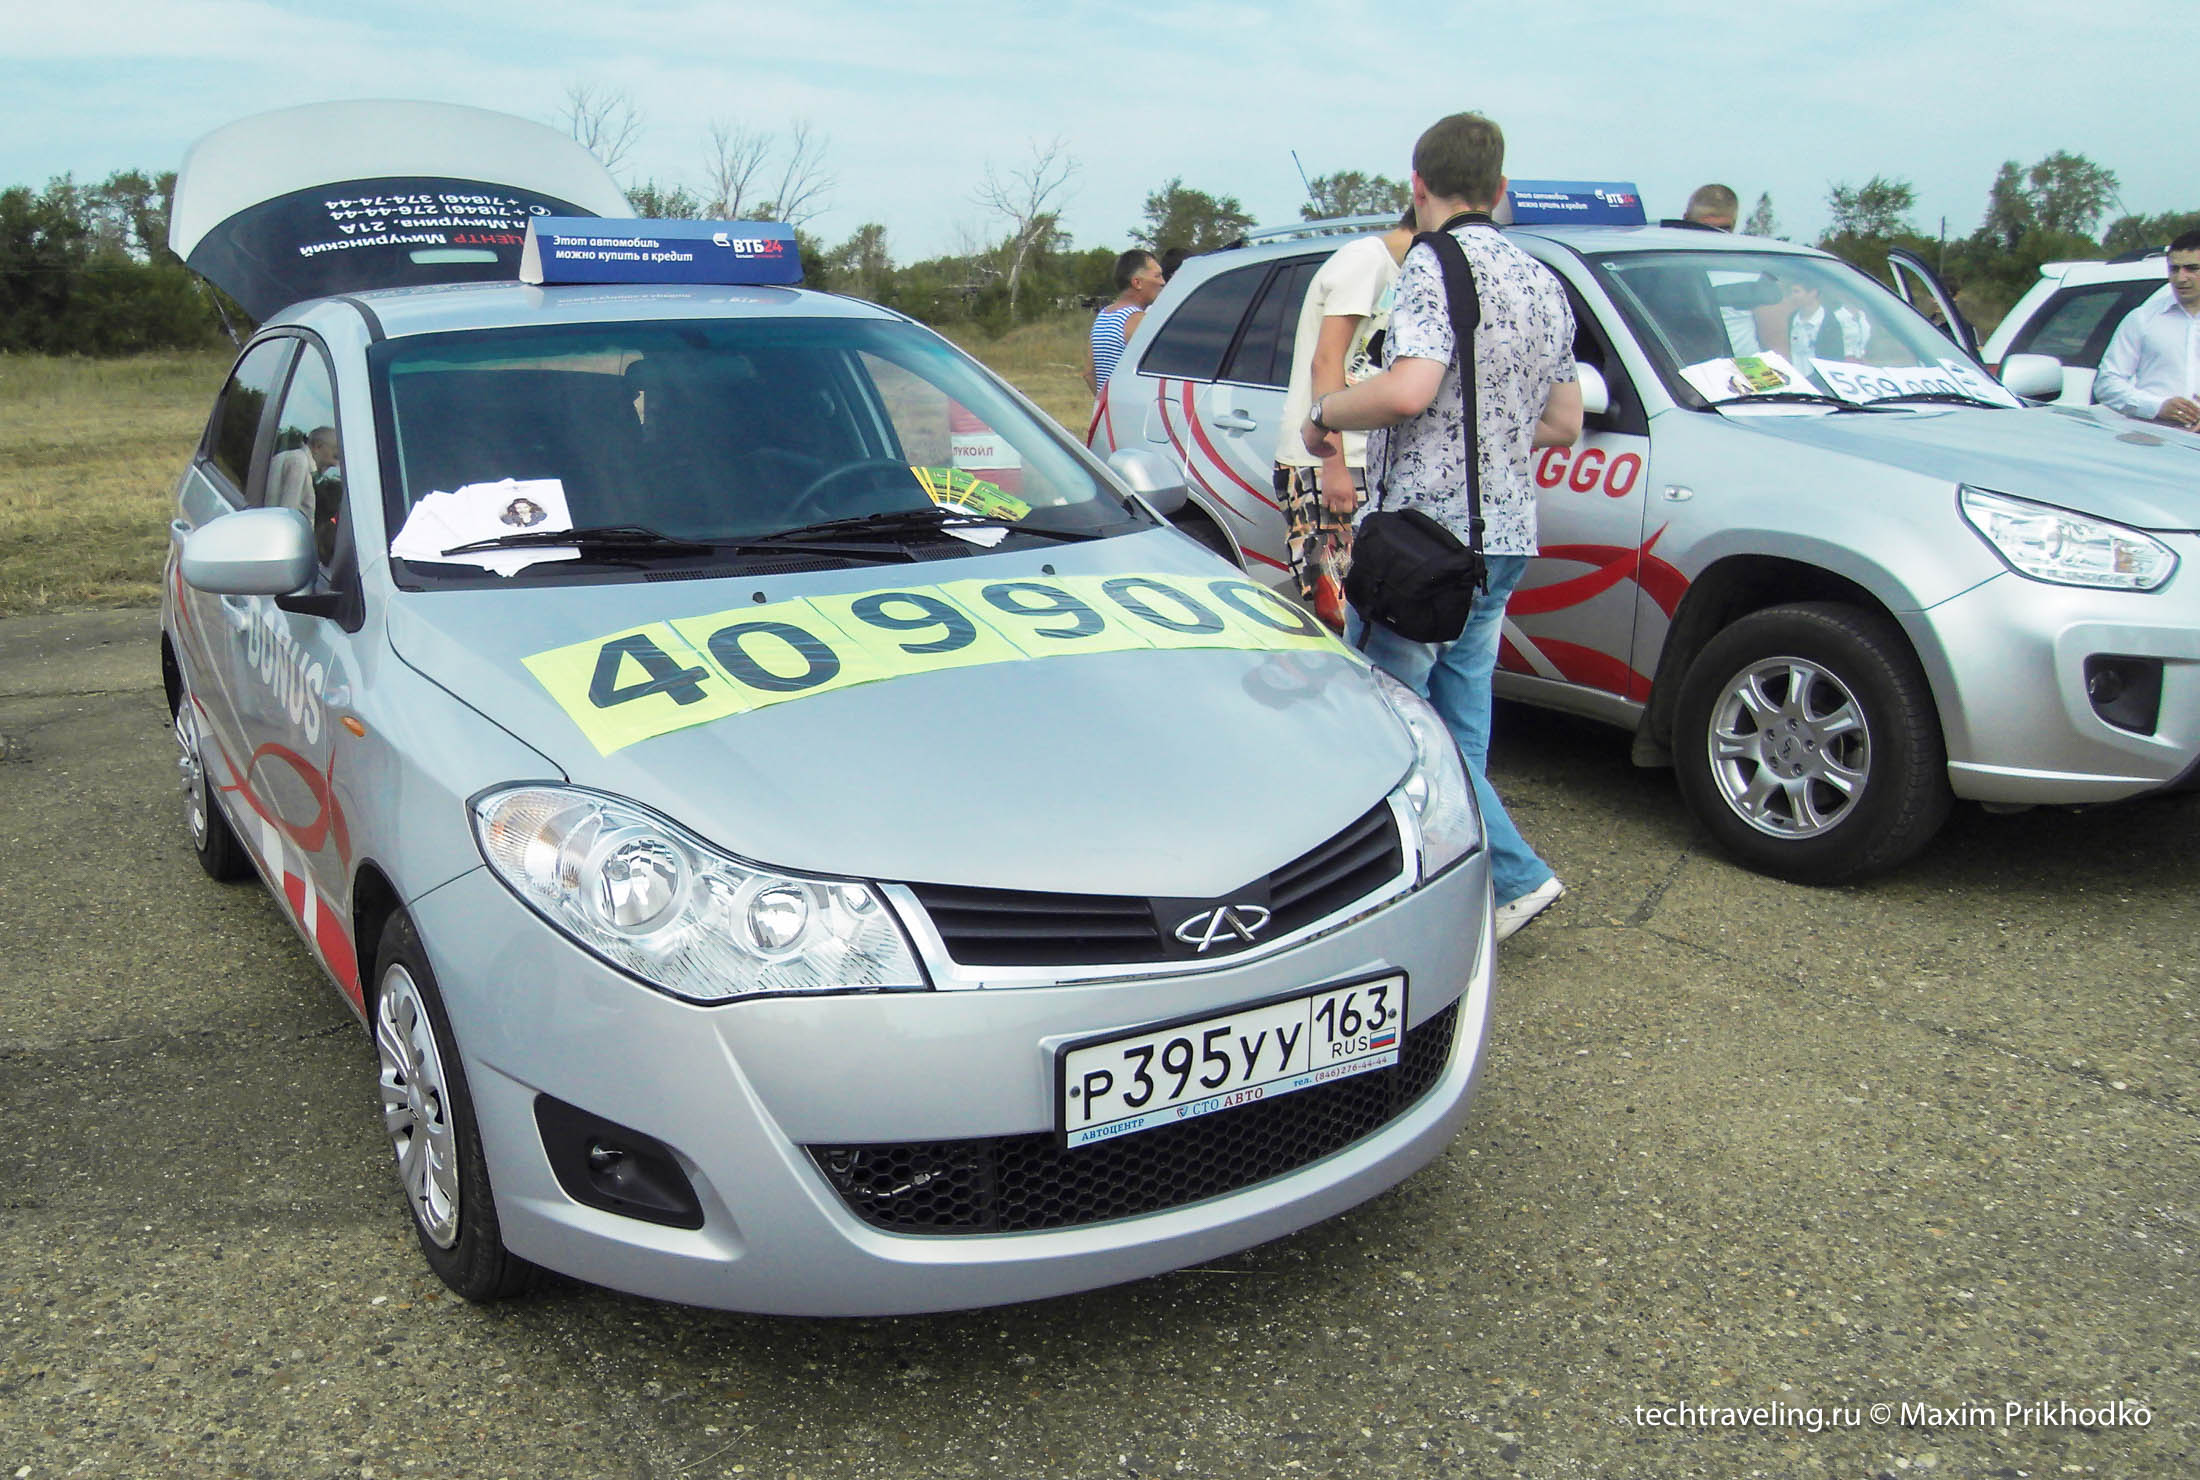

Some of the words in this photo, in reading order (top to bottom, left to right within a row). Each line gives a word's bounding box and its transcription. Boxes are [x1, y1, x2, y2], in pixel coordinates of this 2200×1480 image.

[324, 195, 432, 210] 374-74-44
[330, 205, 438, 221] 276-44-44
[339, 220, 387, 234] 21А
[299, 233, 447, 257] Мичуринский
[453, 233, 525, 246] ЦЕНТР
[553, 235, 587, 246] Этот
[590, 237, 660, 248] автомобиль
[732, 239, 783, 253] ВТБ24
[556, 250, 595, 259] можно
[598, 251, 640, 262] купить
[642, 252, 649, 260] в
[651, 251, 693, 263] кредит
[1530, 445, 1642, 498] GGO
[1315, 985, 1388, 1043] 163
[1332, 1036, 1368, 1059] RUS
[1081, 1118, 1145, 1142] АВТОЦЕНТР
[1192, 1098, 1220, 1116] СТО
[1223, 1087, 1264, 1108] АВТО
